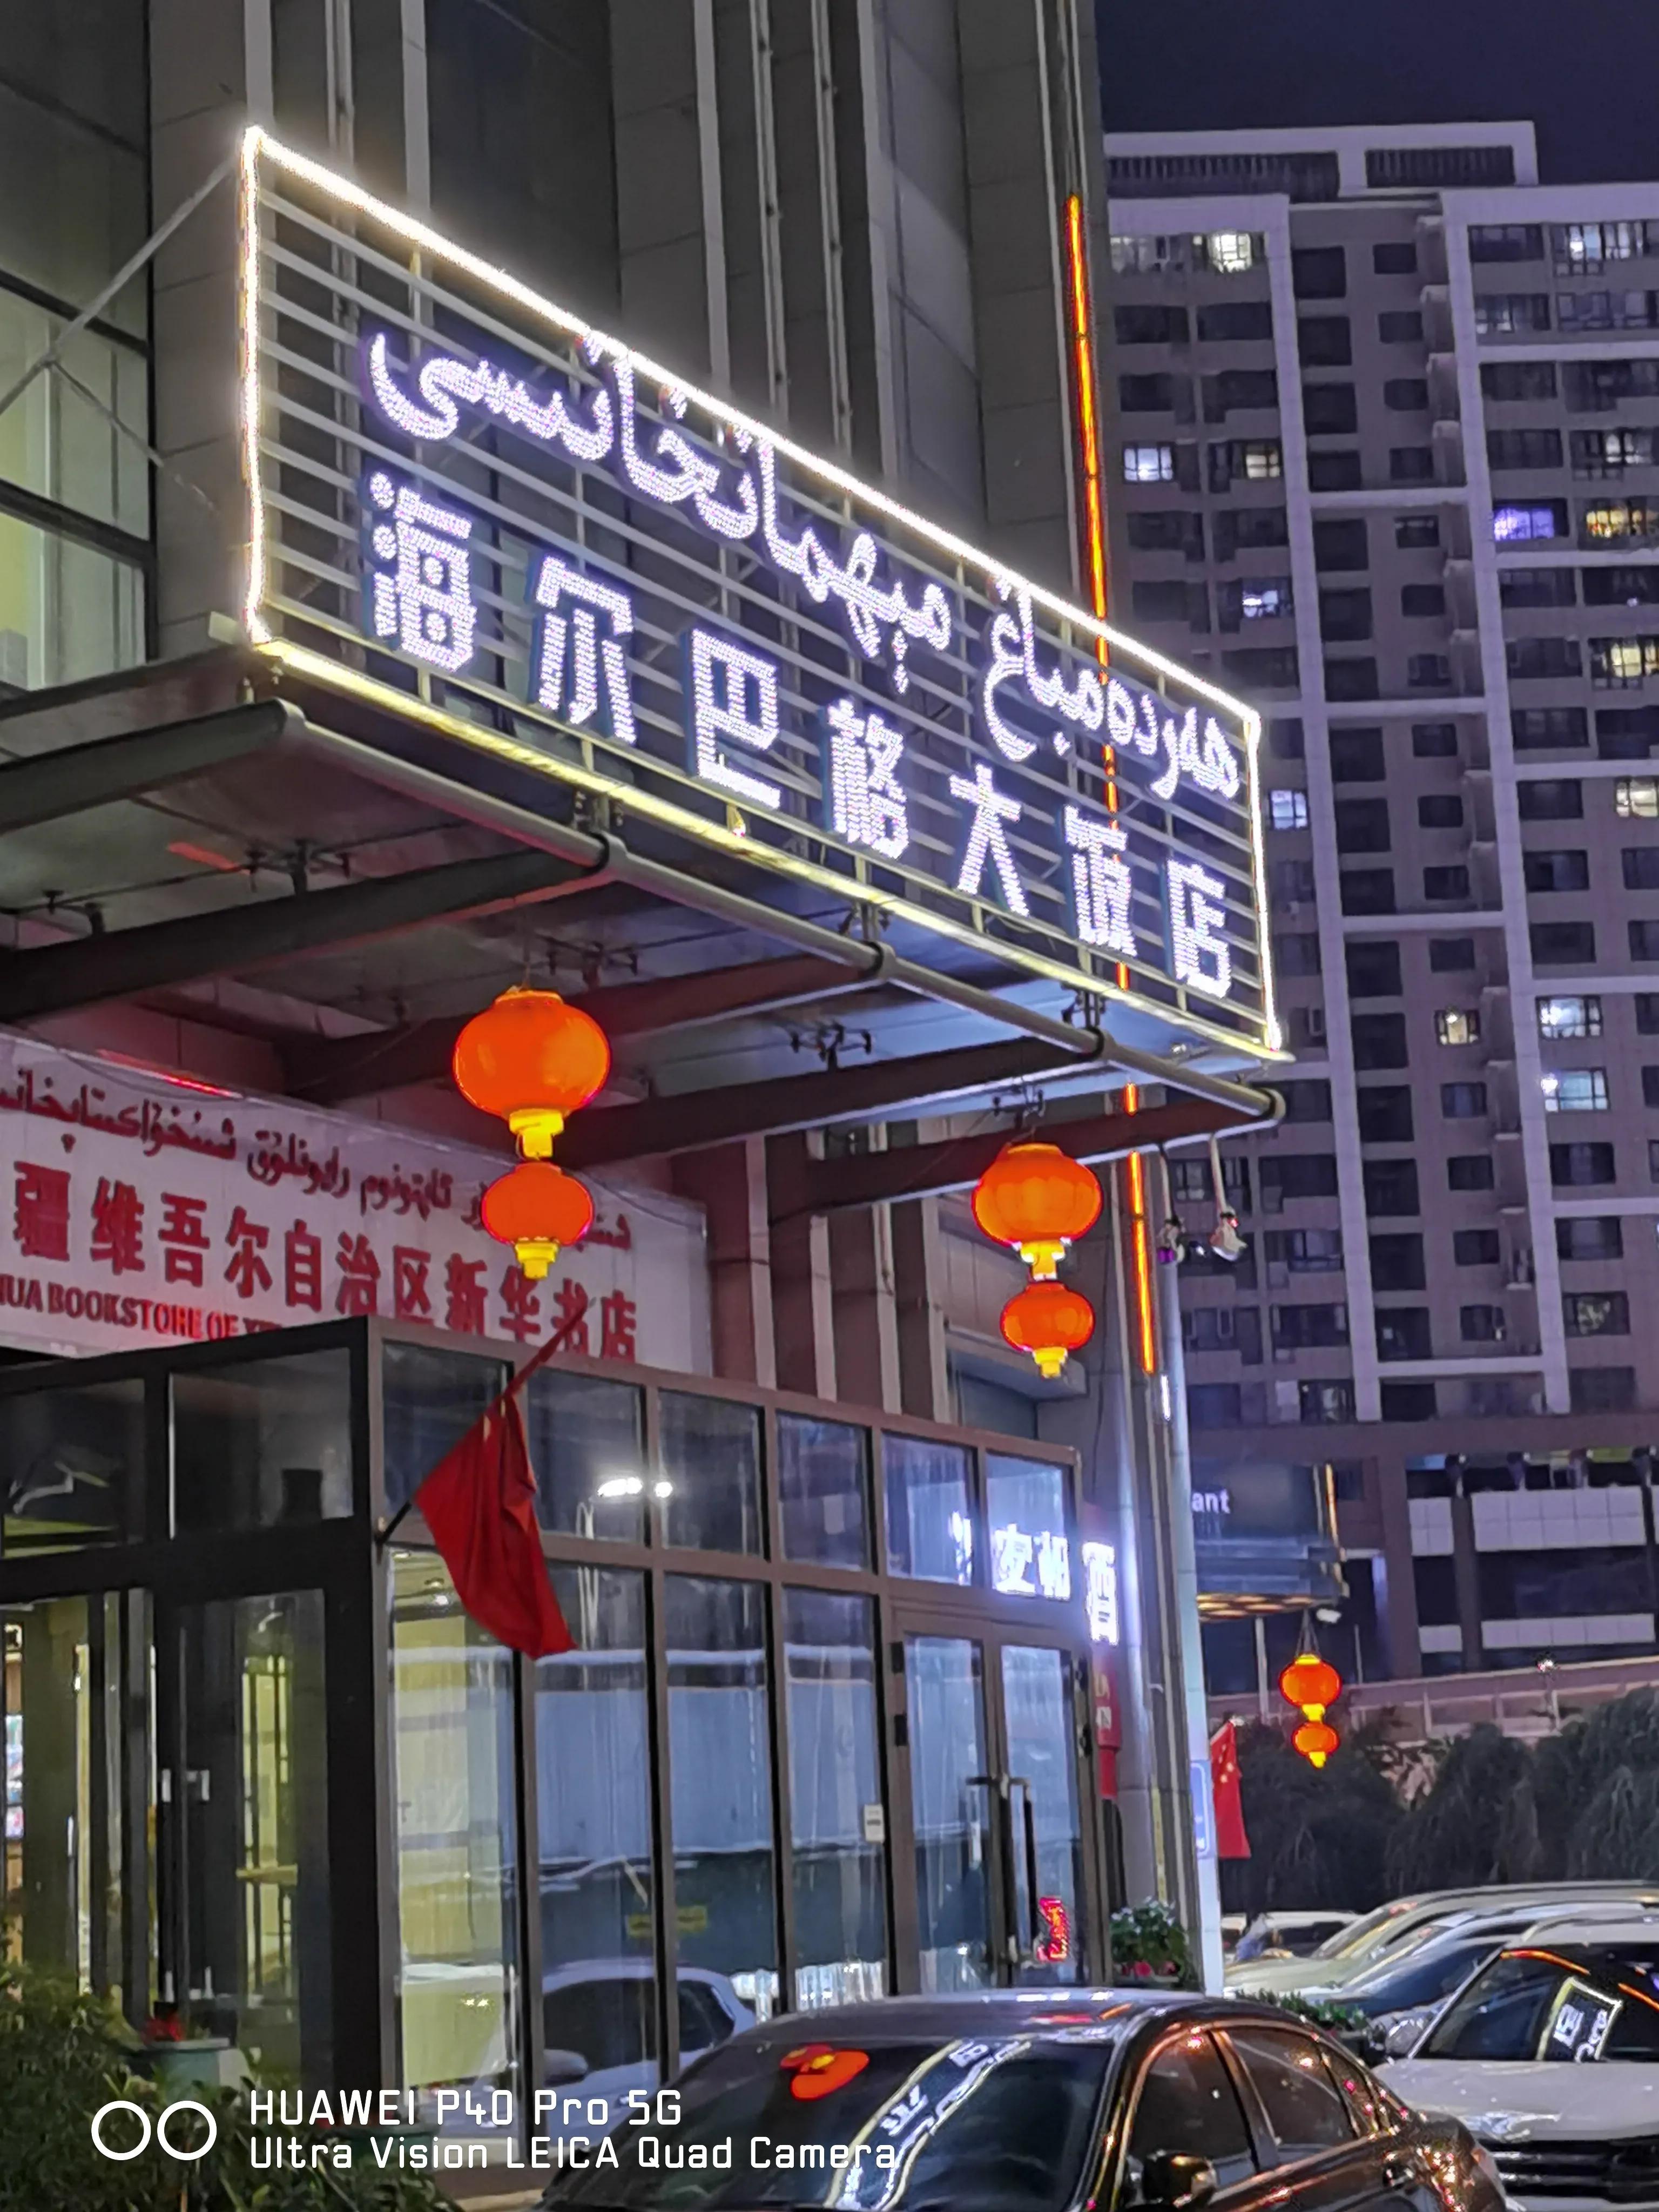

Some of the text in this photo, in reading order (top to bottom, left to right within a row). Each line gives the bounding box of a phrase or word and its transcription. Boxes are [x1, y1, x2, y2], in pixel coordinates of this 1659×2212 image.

[369, 471, 1232, 999] 海尔巴格大饭店
[48, 1281, 204, 1341] BOOKSTORE
[206, 1309, 239, 1342] OF
[1192, 1488, 1231, 1514] ant
